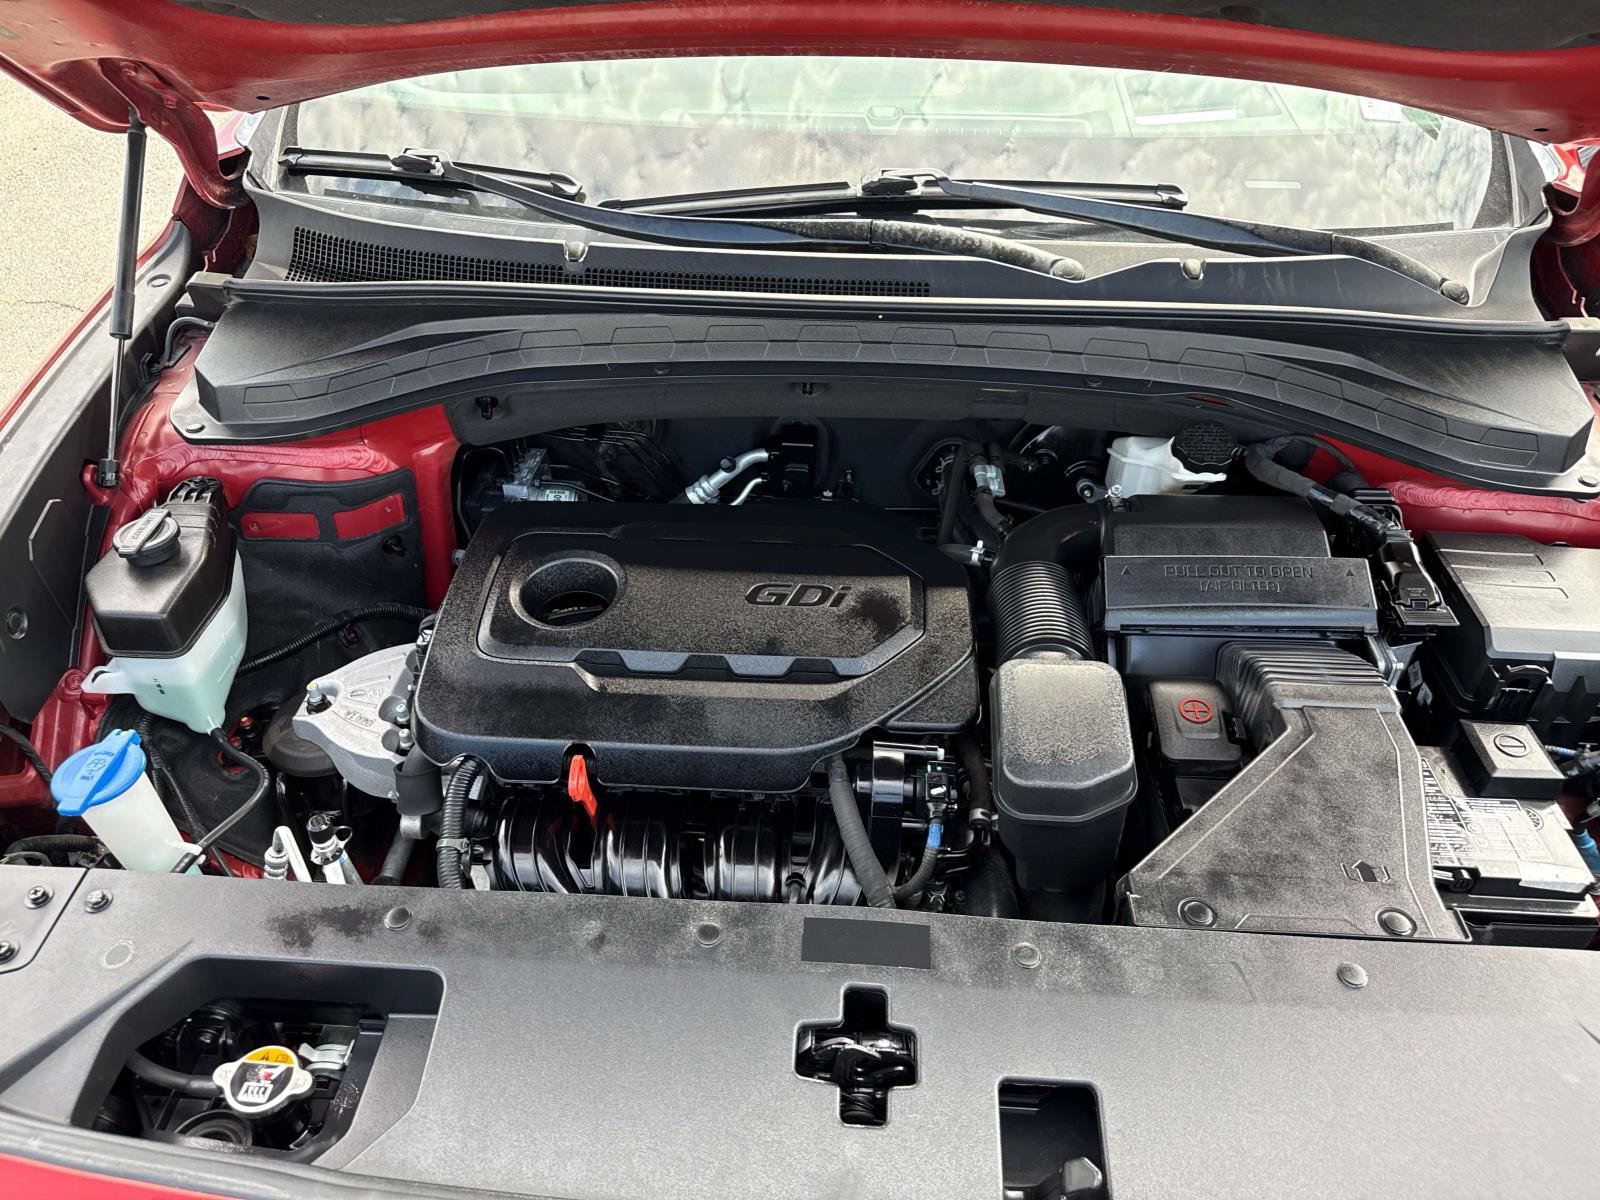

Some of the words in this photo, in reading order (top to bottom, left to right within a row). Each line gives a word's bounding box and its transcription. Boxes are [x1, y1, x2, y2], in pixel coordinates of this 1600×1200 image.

[1164, 565, 1206, 578] PULL
[1208, 565, 1240, 578] OUT
[1244, 565, 1266, 578] TO
[1269, 565, 1314, 579] OPEN
[744, 582, 853, 607] GDi
